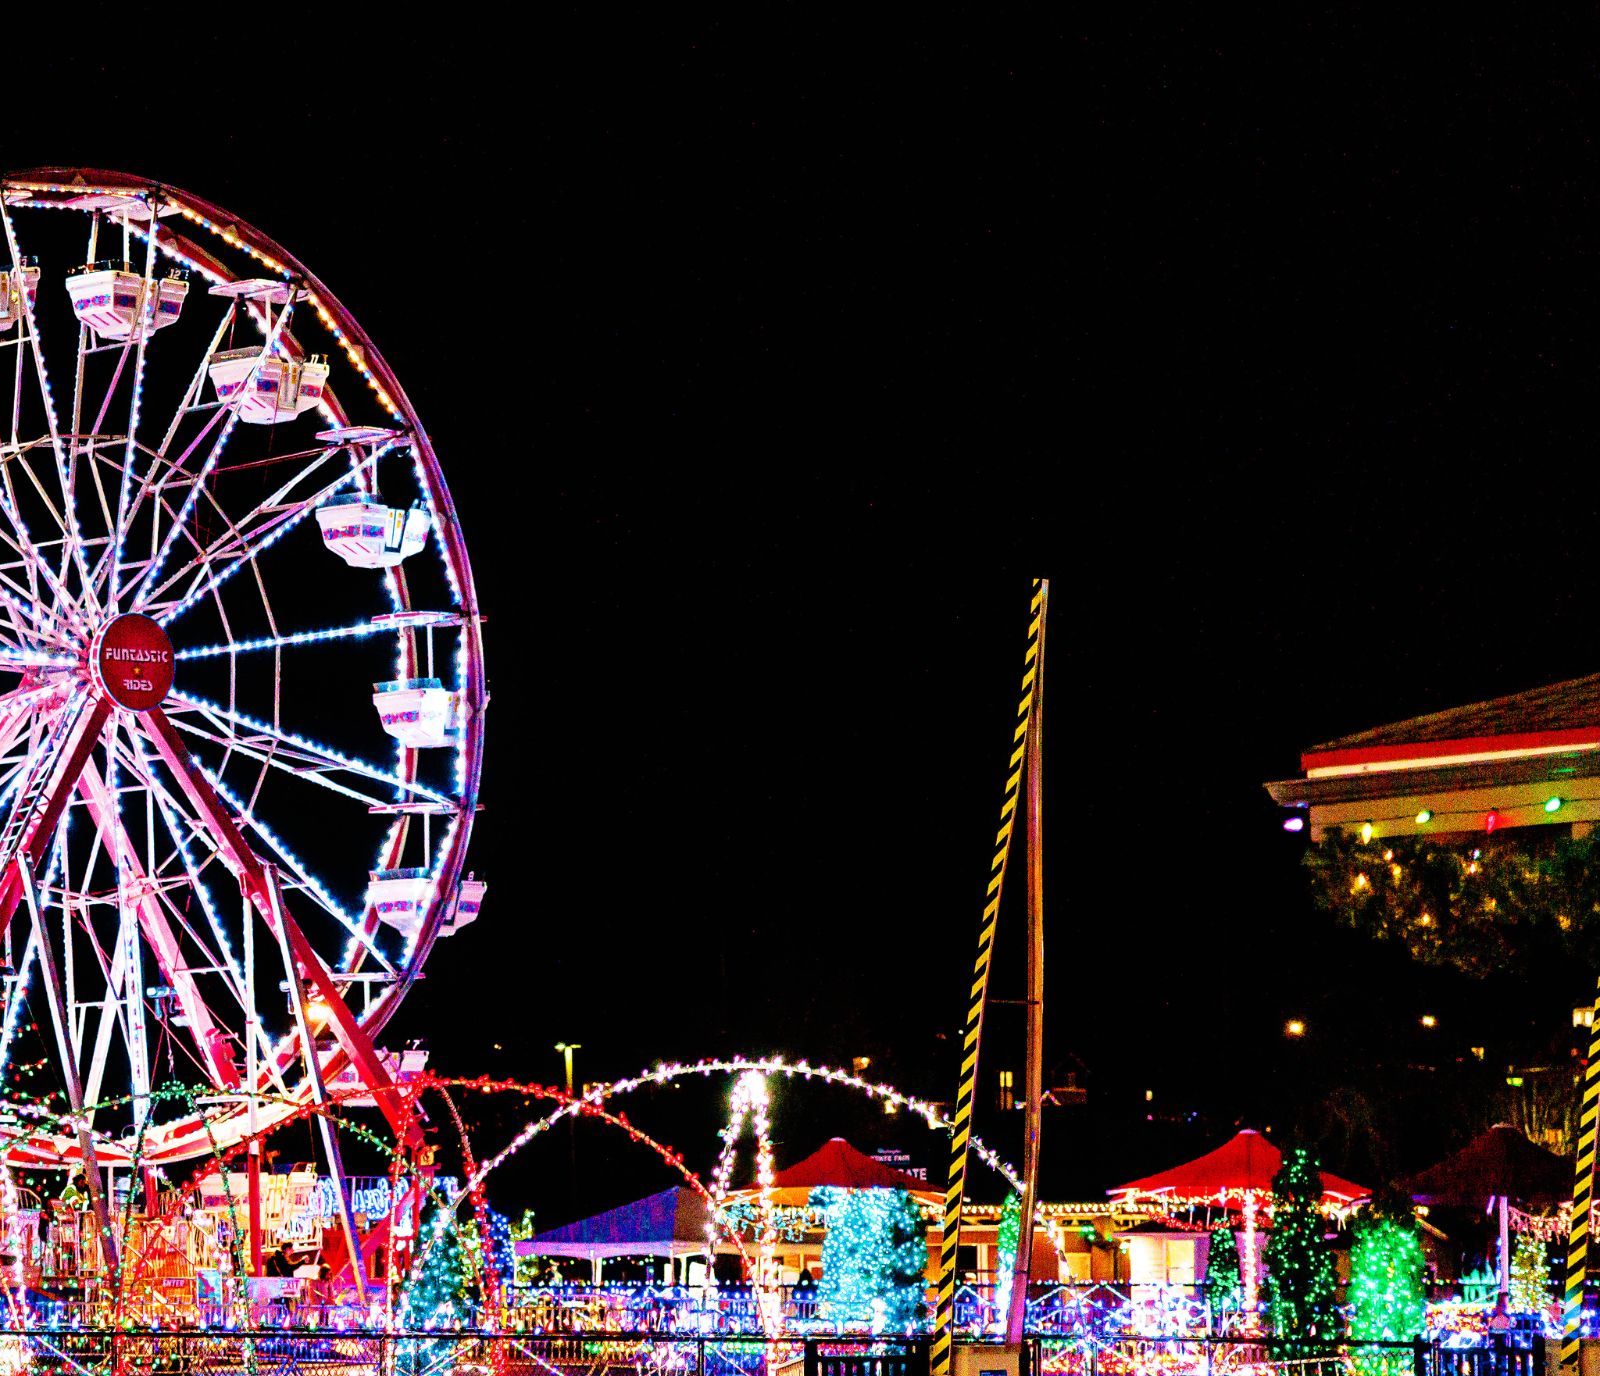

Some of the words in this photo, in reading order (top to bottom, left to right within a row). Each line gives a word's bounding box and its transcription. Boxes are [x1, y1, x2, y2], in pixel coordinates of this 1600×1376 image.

[170, 268, 181, 280] 12
[105, 647, 168, 663] FUNTASTIC
[123, 679, 153, 691] RIDES
[280, 1279, 300, 1289] EXIT
